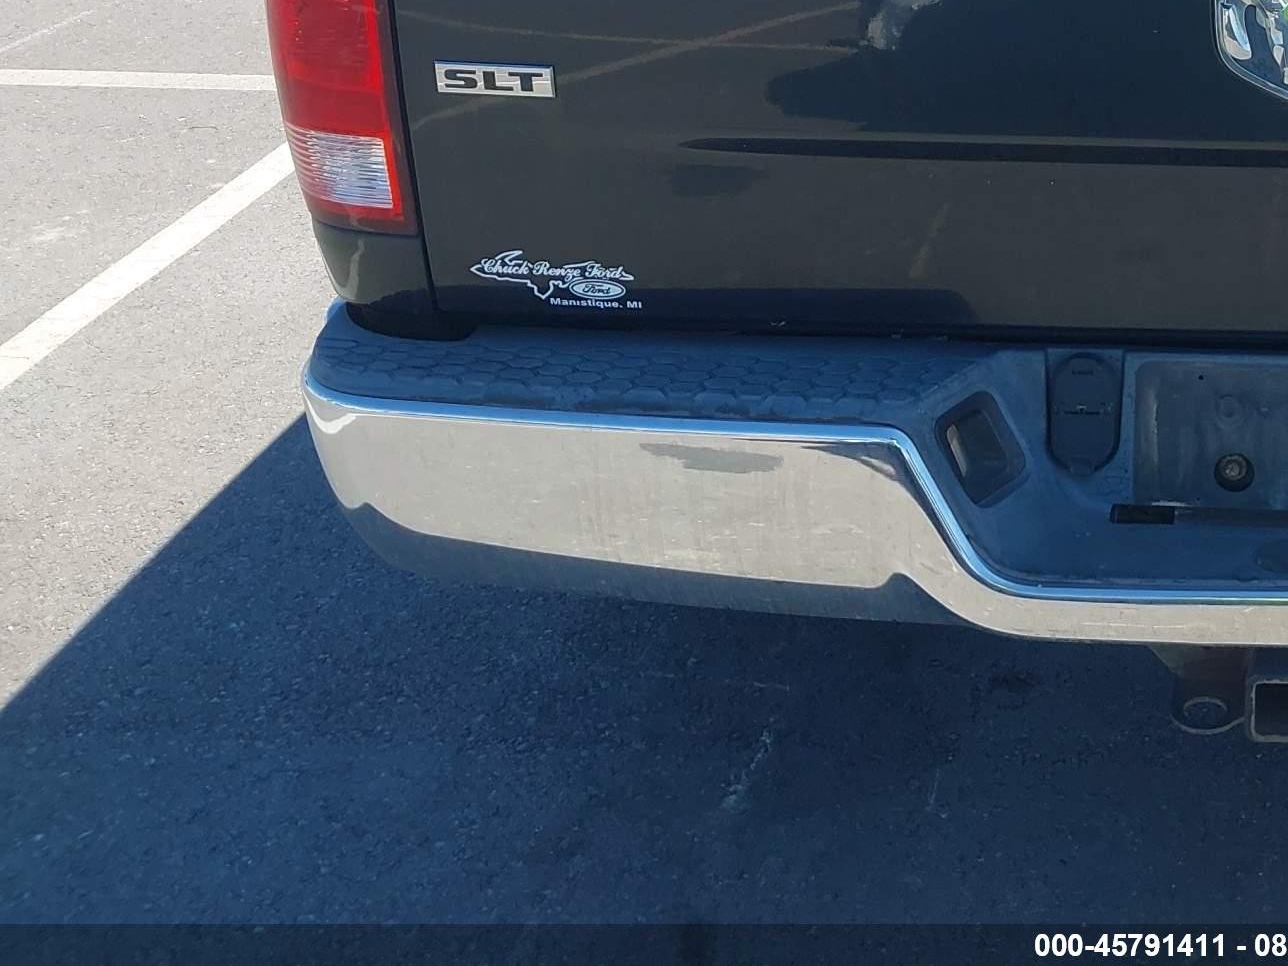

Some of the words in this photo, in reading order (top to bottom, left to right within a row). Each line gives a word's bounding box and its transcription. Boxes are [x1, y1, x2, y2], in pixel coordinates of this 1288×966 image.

[443, 68, 545, 93] SLT
[480, 258, 530, 275] Chuck
[585, 262, 624, 279] Ford
[582, 284, 611, 295] Ford
[626, 300, 643, 309] MI
